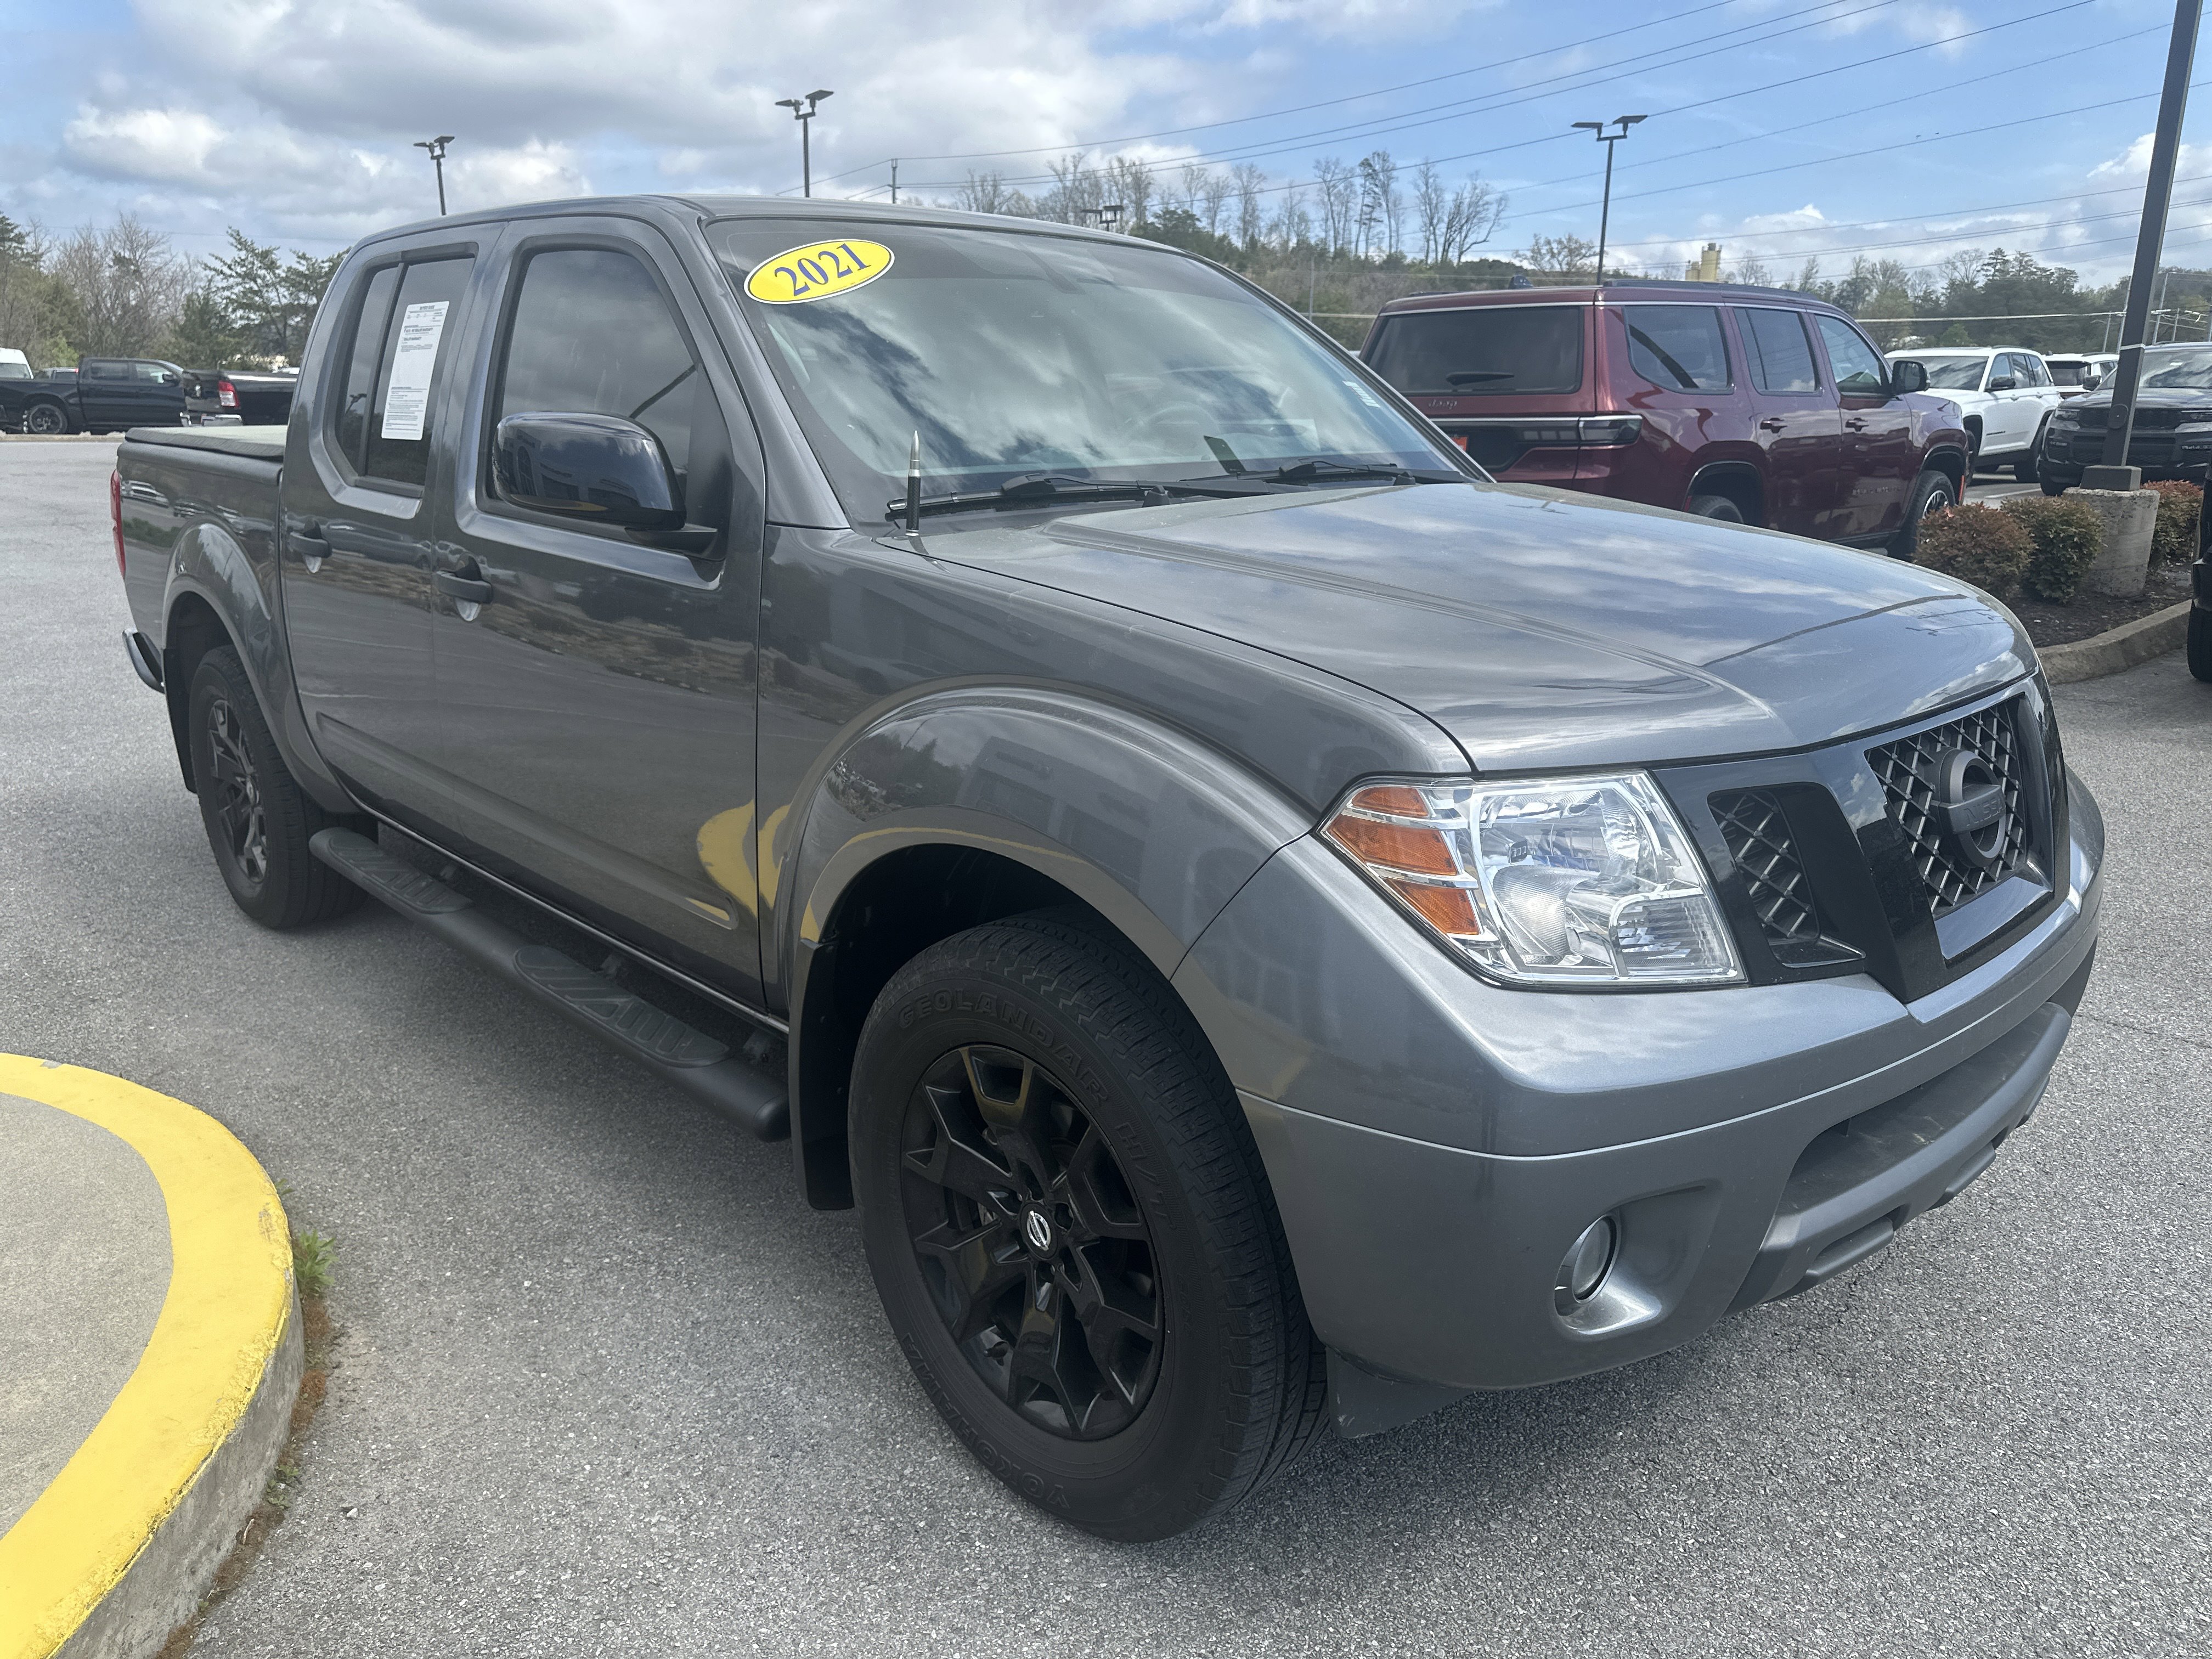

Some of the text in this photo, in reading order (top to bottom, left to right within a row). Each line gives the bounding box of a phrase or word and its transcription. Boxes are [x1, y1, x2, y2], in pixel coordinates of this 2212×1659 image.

[774, 243, 872, 297] 2021
[898, 988, 1109, 1104] GEOLANDAR
[1114, 1121, 1177, 1231] H/T
[902, 1331, 1071, 1510] YOKOHAMA
